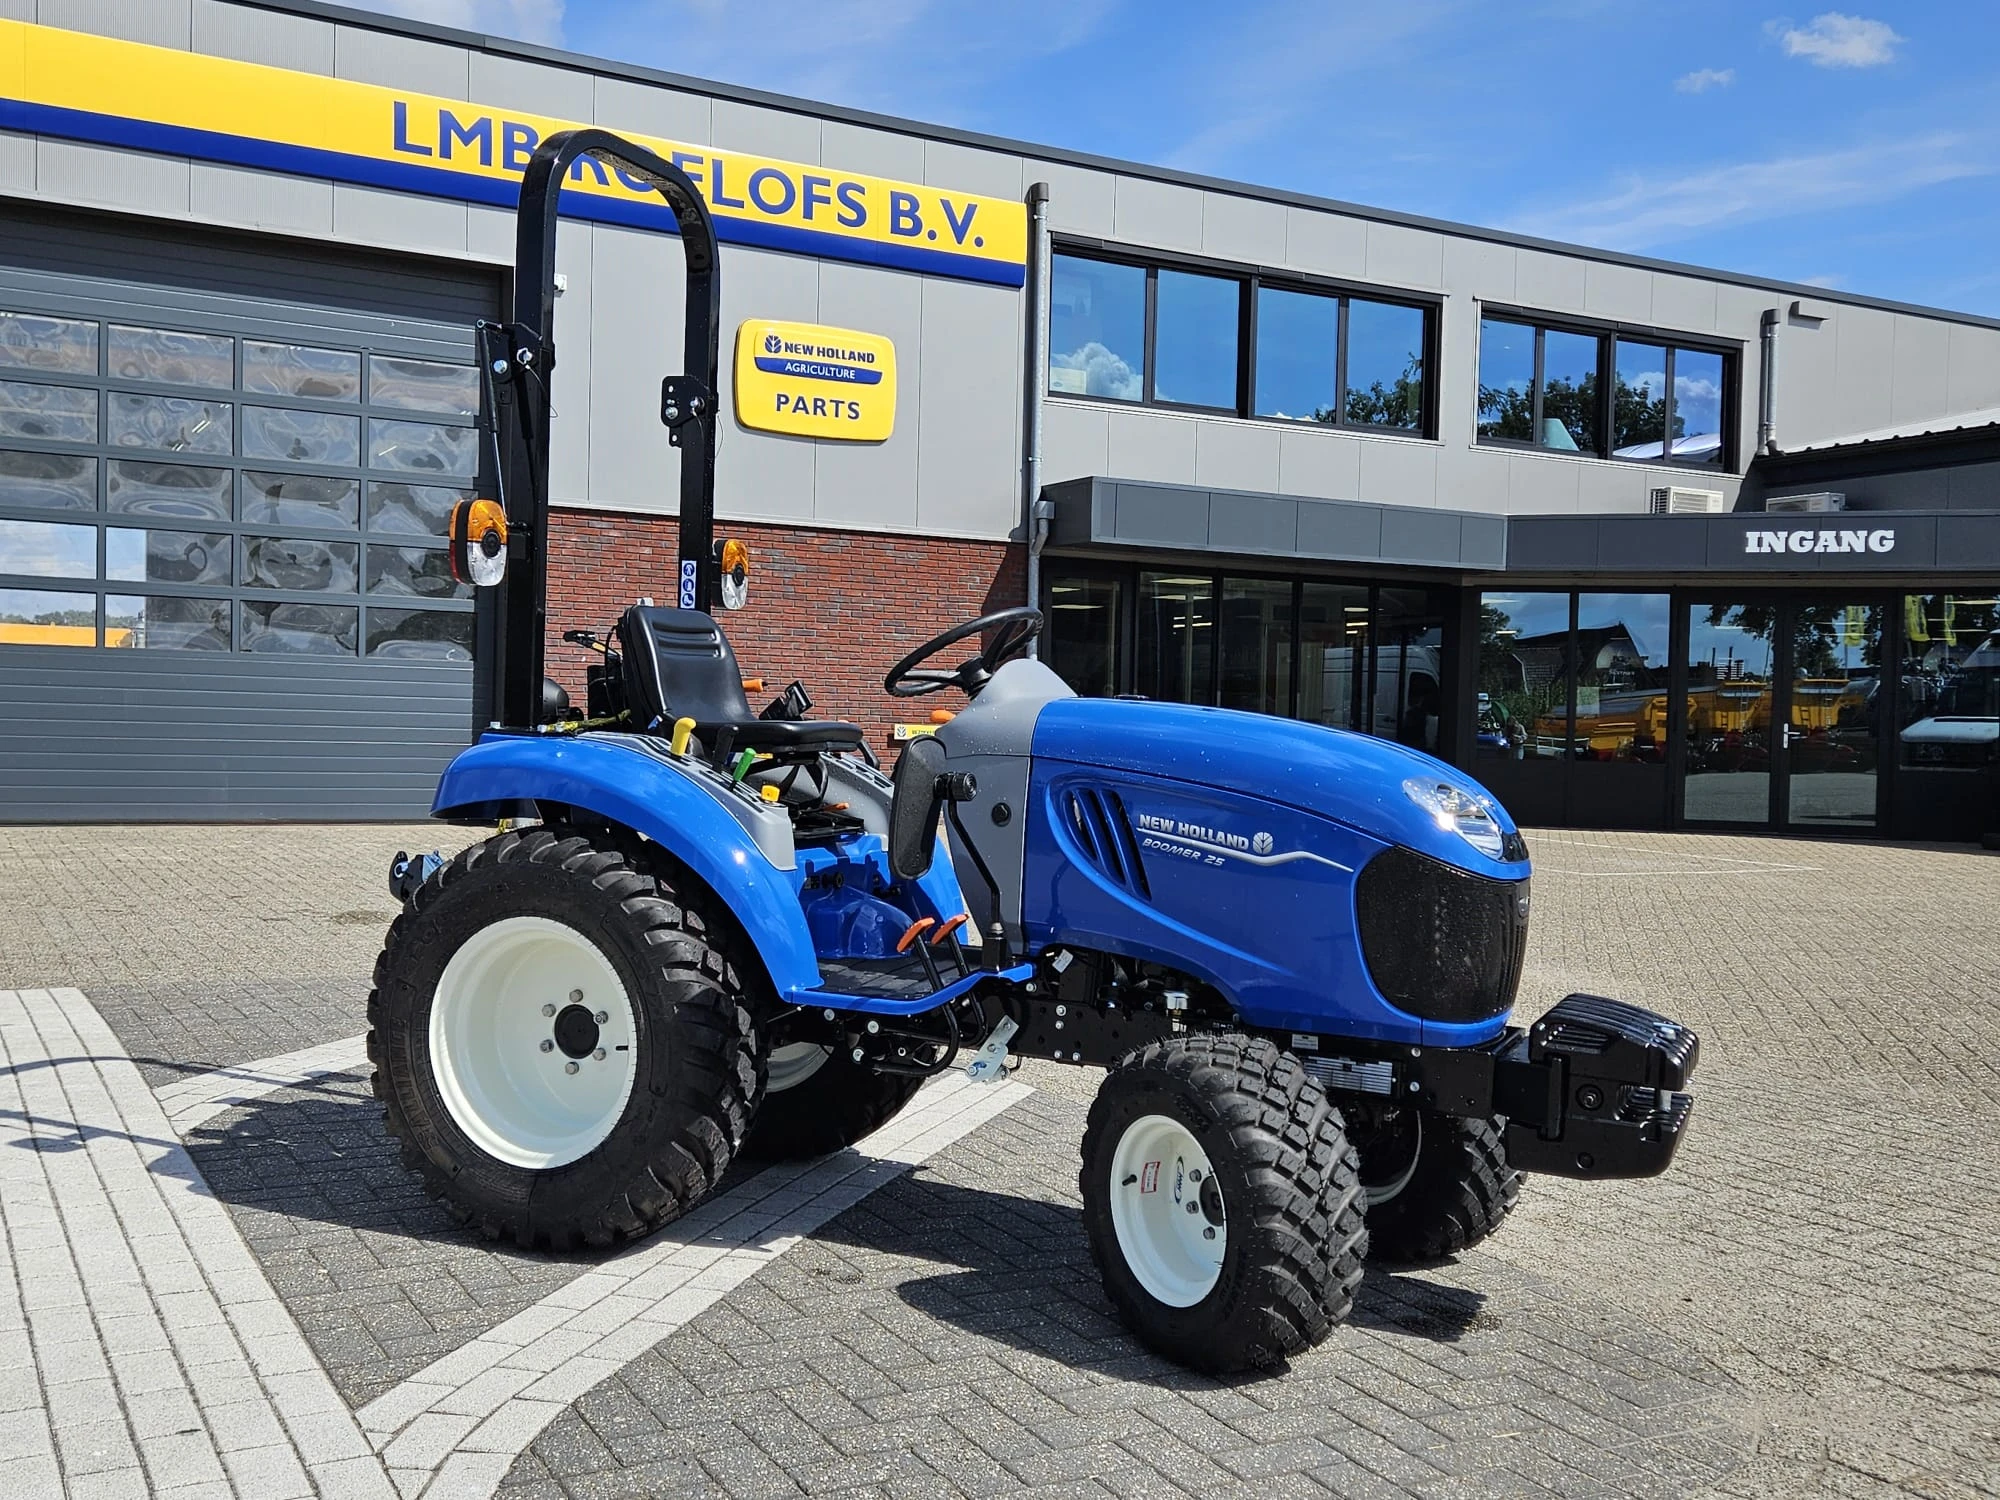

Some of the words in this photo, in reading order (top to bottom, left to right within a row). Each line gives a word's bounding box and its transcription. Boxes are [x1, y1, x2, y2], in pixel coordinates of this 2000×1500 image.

[394, 101, 539, 172] LMB
[890, 190, 984, 248] B.V.
[785, 342, 814, 356] NEW
[817, 346, 875, 364] HOLLAND
[785, 362, 856, 380] AGRICULTURE
[776, 393, 860, 420] PARTS
[1745, 530, 1895, 553] INGANG
[1140, 814, 1175, 833] NEW
[1178, 822, 1249, 851] HOLLAND
[1142, 838, 1201, 860] BOOMER
[1204, 854, 1226, 867] 25
